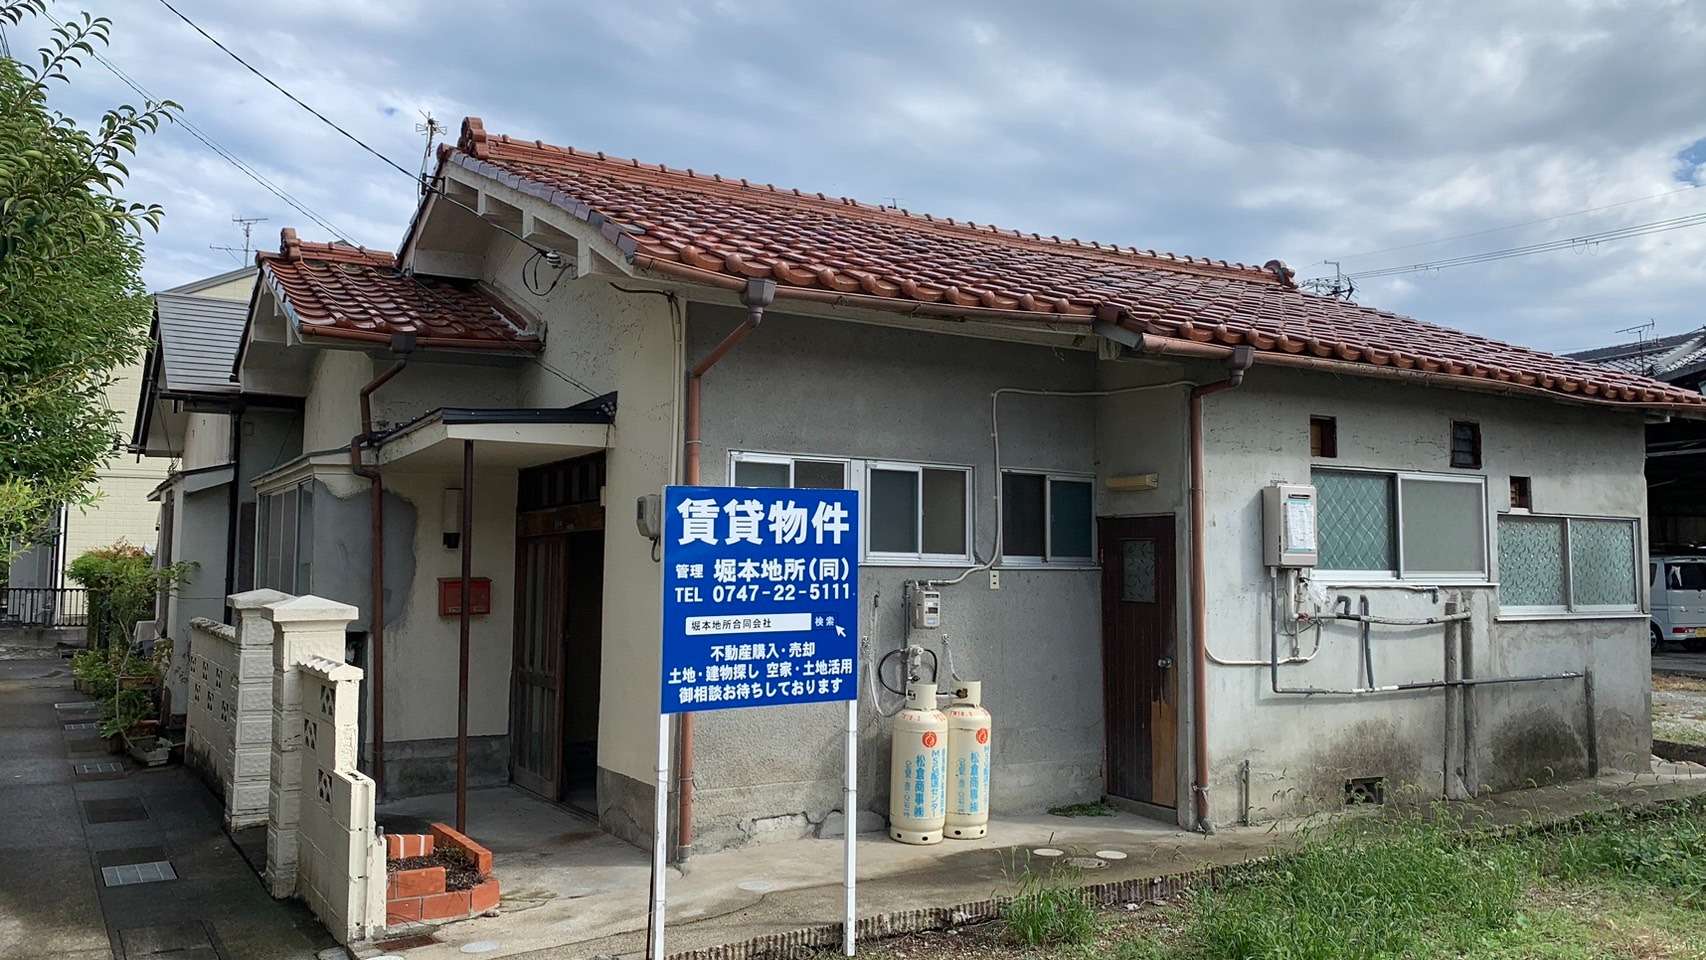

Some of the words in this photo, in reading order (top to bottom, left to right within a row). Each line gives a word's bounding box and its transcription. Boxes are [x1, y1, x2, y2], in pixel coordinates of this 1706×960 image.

[677, 497, 850, 546] 賃貸物件
[675, 563, 704, 579] 管理
[674, 586, 703, 603] TEL
[712, 583, 850, 603] 0747-22-5111
[691, 617, 772, 632] 堀本地所合同会社
[814, 615, 836, 627] 検索
[710, 641, 816, 662] 不動産購入・売却
[668, 663, 760, 684] 土地・建物探し
[766, 658, 853, 678] 空家・土地活用
[678, 677, 843, 704] 御相談お待ちしております
